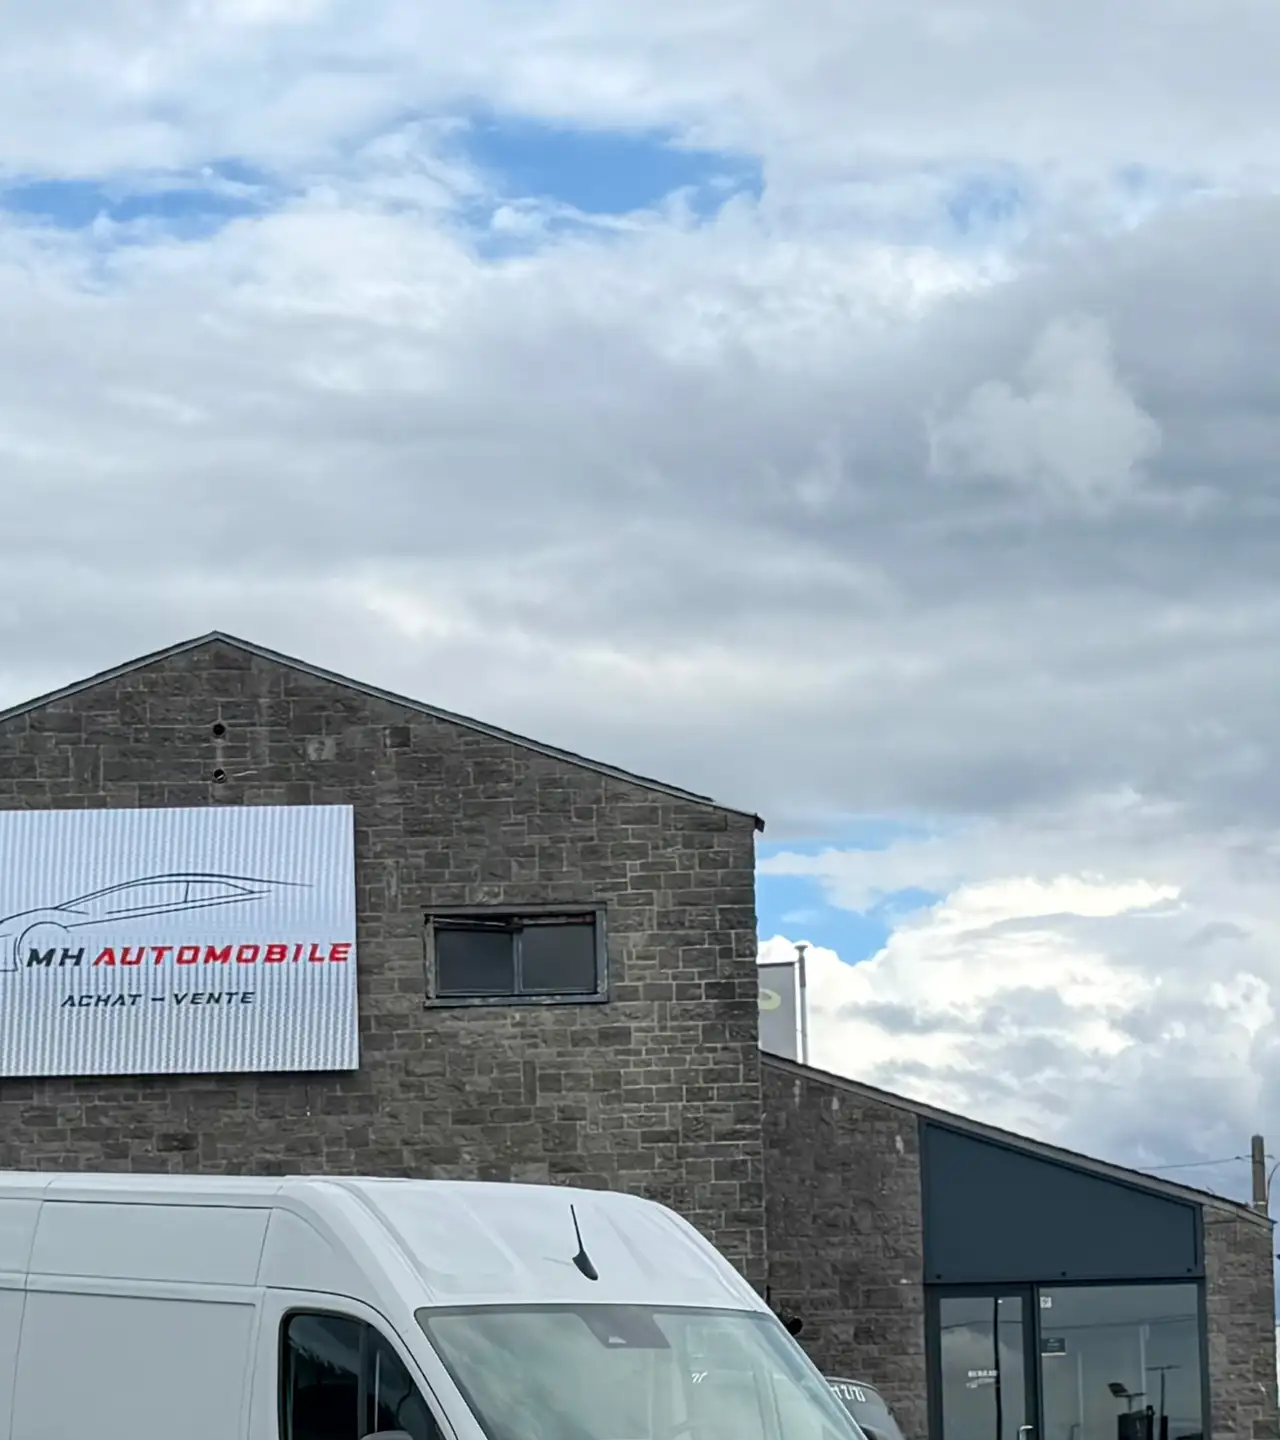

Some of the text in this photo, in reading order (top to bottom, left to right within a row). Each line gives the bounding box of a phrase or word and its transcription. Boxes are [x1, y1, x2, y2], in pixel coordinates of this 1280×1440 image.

[27, 943, 352, 967] MH AUTOMOBILE
[61, 994, 142, 1008] ACHAT
[173, 992, 256, 1006] VENTE
